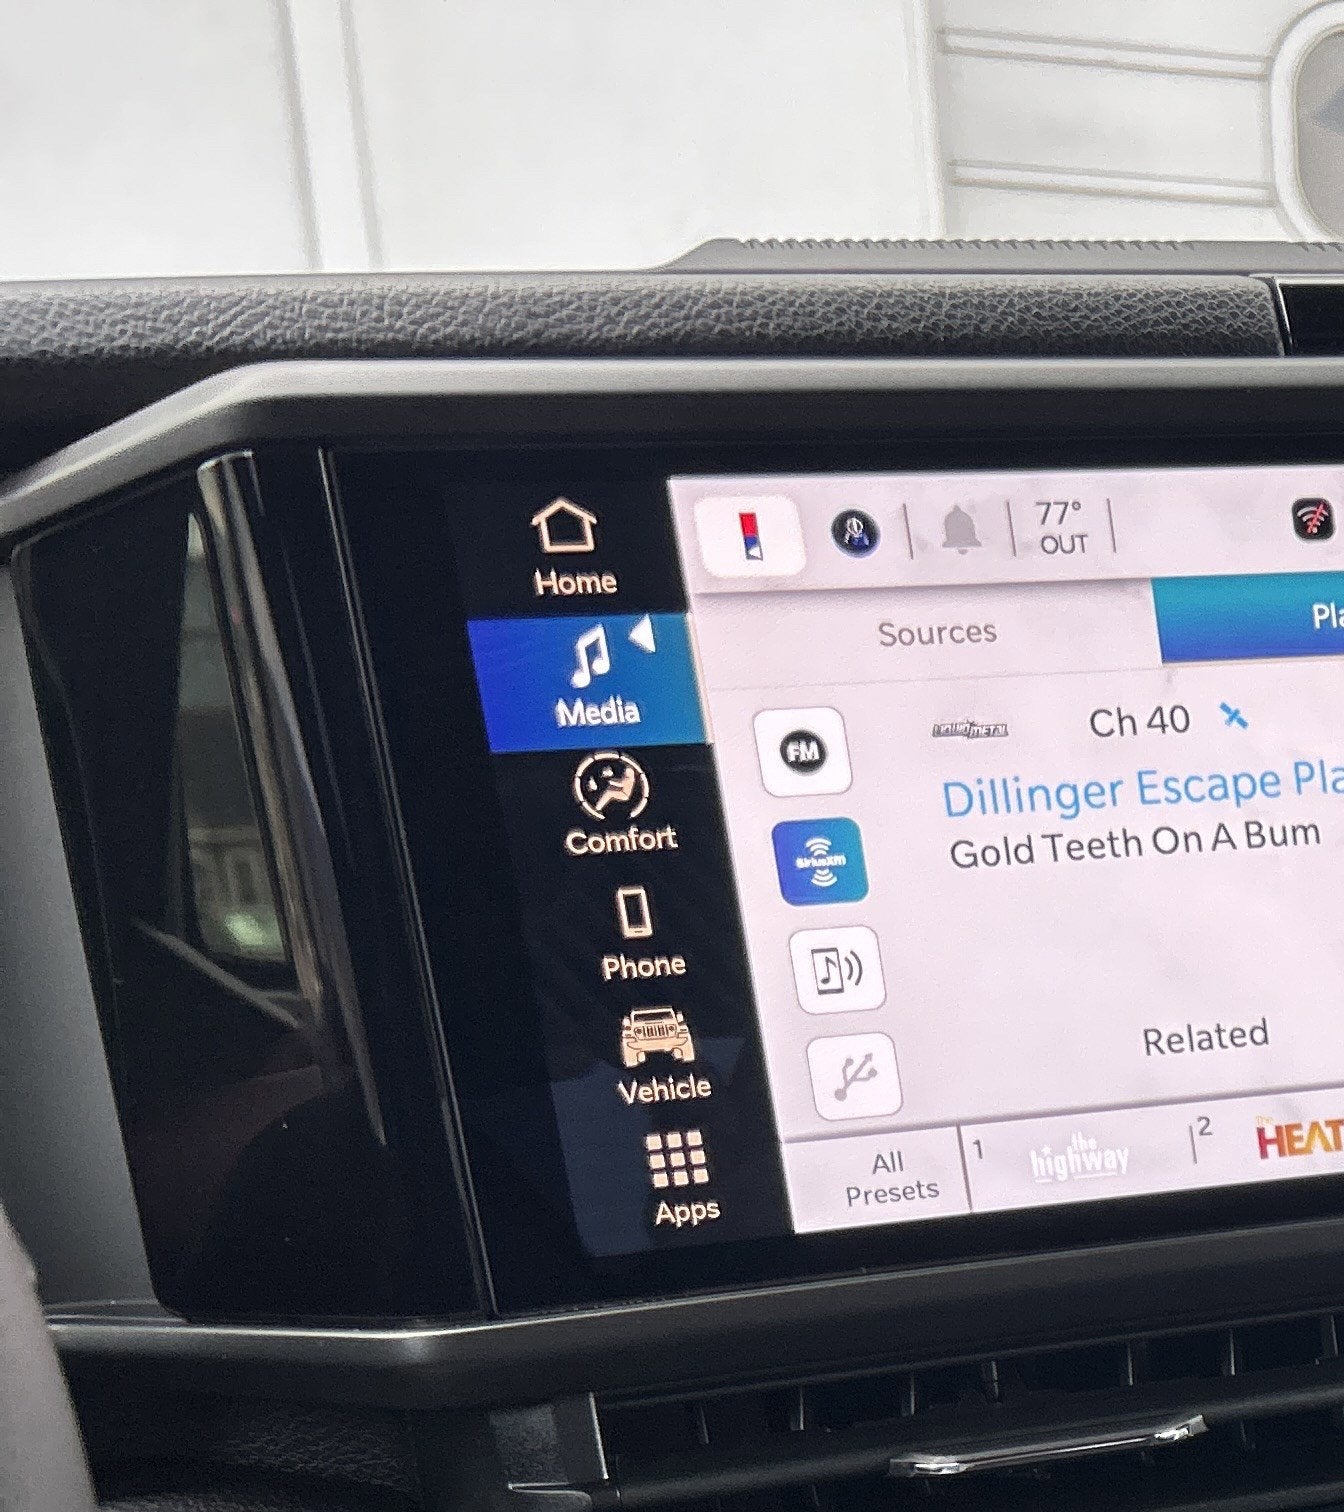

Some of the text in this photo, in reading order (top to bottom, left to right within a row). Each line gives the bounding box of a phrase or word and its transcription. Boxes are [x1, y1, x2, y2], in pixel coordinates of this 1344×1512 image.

[1036, 501, 1081, 526] 77°
[1041, 534, 1088, 555] OUT
[534, 569, 617, 596] Home
[878, 621, 997, 647] Sources
[555, 697, 641, 728] Media
[1090, 705, 1191, 738] Ch 40
[786, 741, 820, 763] FM
[943, 777, 1123, 819] Dillinger
[1137, 769, 1282, 808] Escape
[565, 826, 678, 856] Comfort
[950, 819, 1321, 869] Gold Teeth On A Bum
[601, 954, 687, 981] Phone
[1143, 1017, 1270, 1057] Related
[617, 1072, 712, 1105] Vehicle
[1198, 1116, 1213, 1137] 2
[872, 1151, 904, 1174] All
[973, 1140, 985, 1161] 1
[1030, 1145, 1130, 1182] highway
[845, 1179, 940, 1208] Presets
[655, 1198, 721, 1229] Apps
